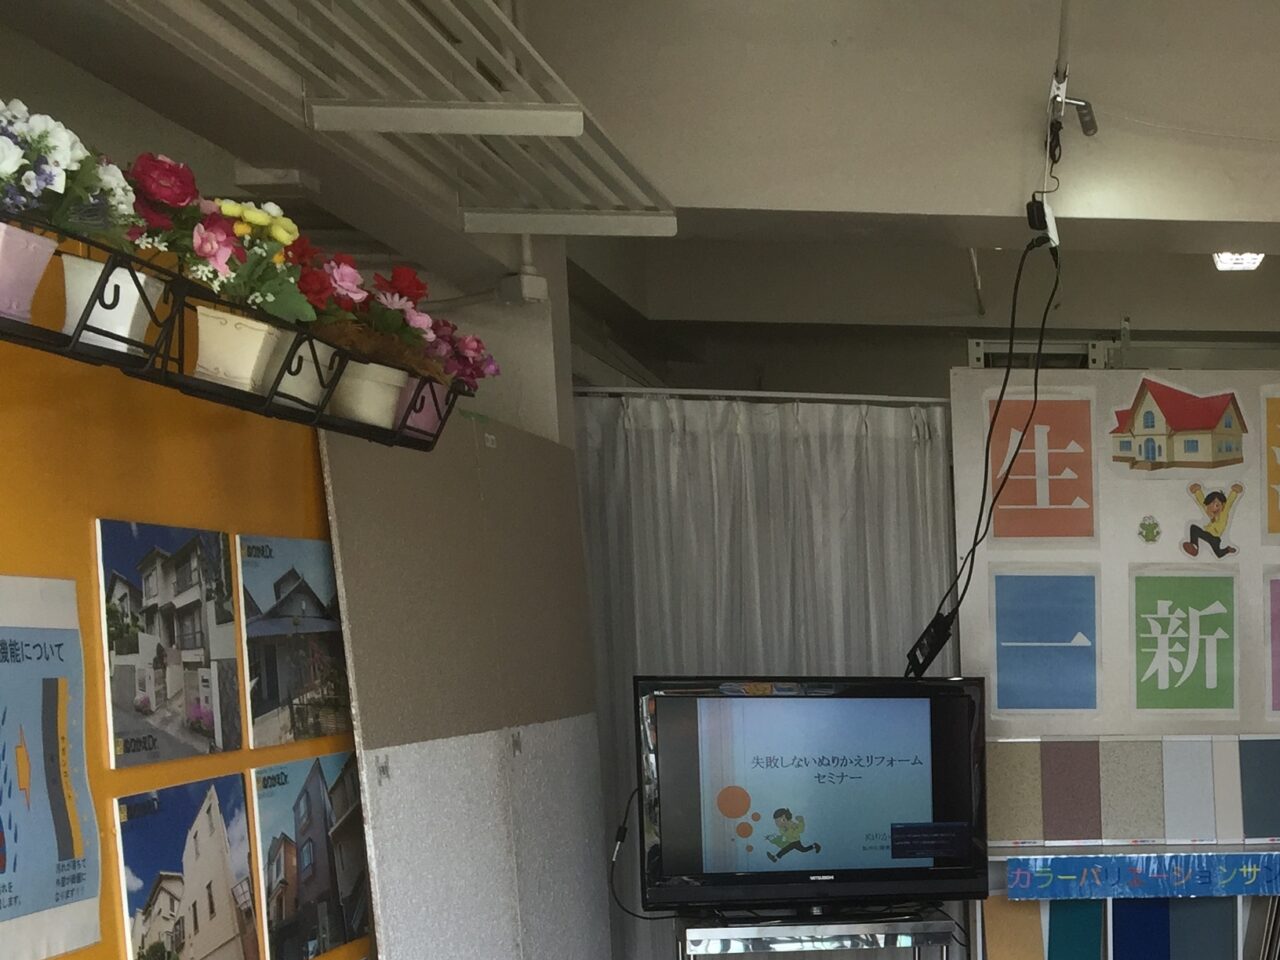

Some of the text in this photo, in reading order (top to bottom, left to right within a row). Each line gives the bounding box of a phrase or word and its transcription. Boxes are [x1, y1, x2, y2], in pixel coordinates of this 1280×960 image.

[996, 423, 1090, 511] 生
[1140, 599, 1230, 690] 新
[751, 754, 924, 769] 失敗しないぬりかえリフォーム
[813, 771, 863, 785] セミナー
